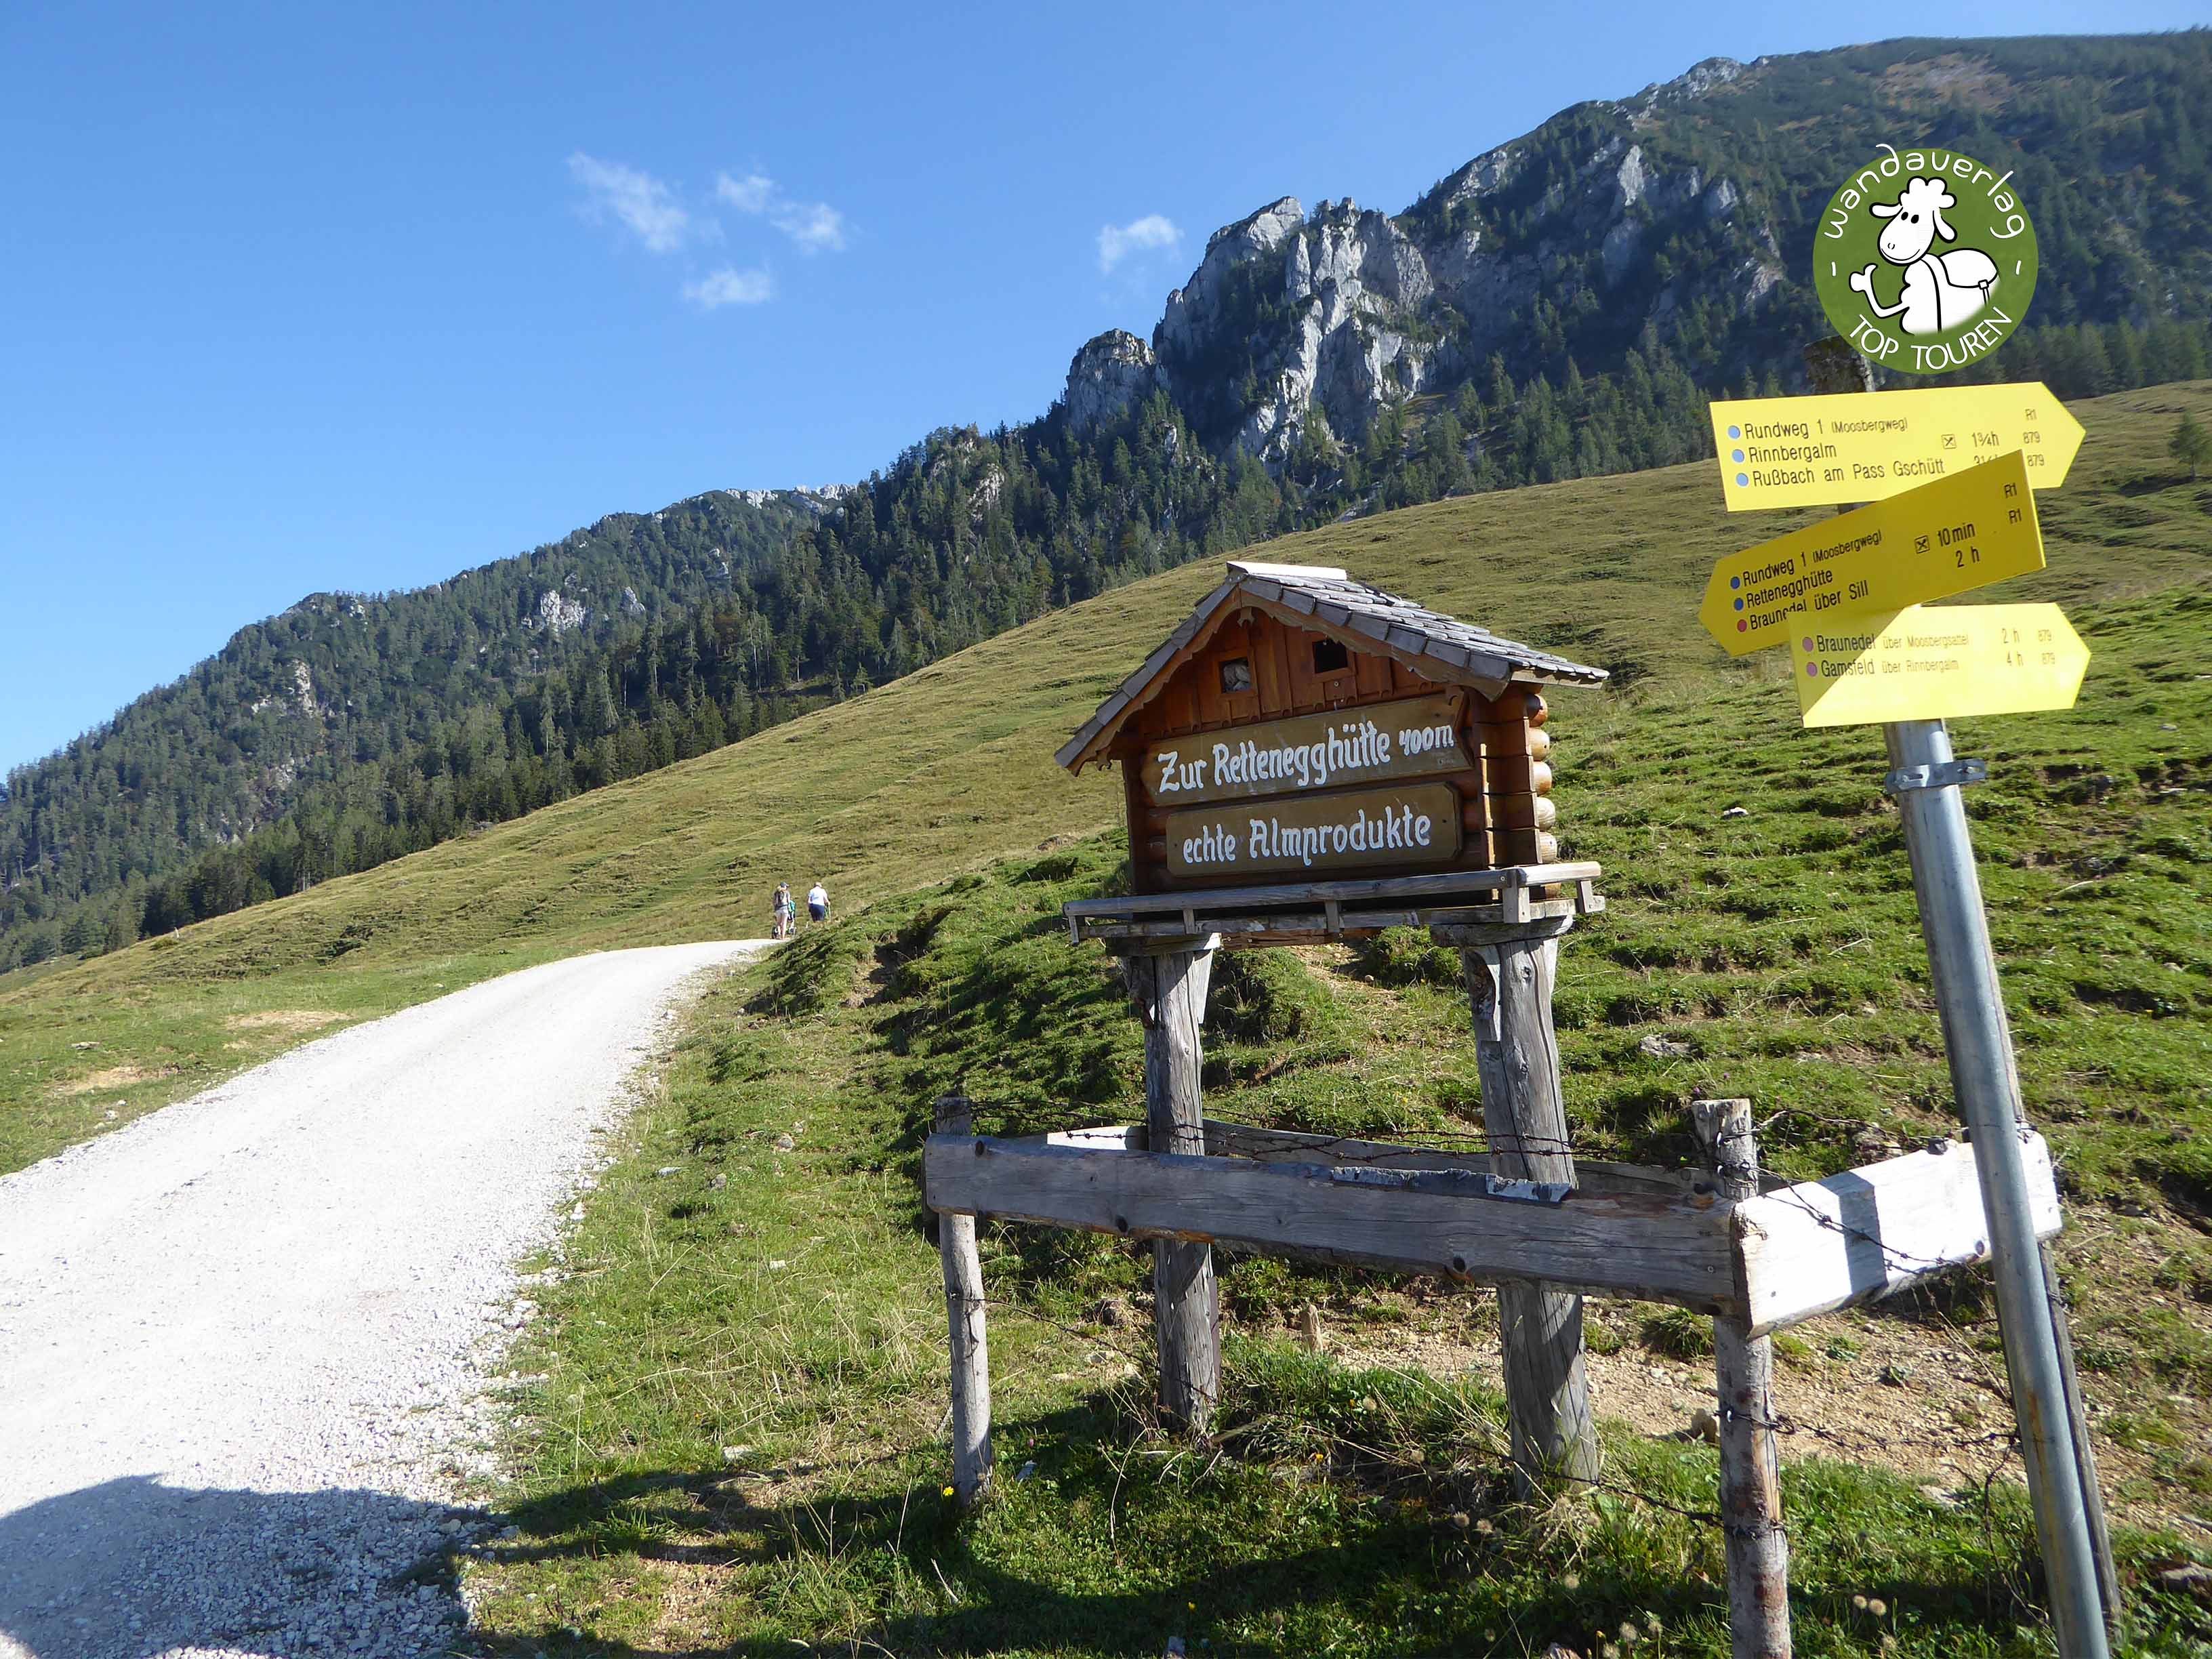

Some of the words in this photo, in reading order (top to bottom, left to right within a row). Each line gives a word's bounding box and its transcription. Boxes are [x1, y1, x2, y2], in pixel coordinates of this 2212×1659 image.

[1744, 422, 1809, 439] Rundweg
[1817, 419, 1823, 434] 1
[2025, 409, 2037, 421] R1
[1748, 443, 1837, 463] Rinnbergalm
[2023, 431, 2041, 444] 879
[1753, 468, 1815, 487] Rußbach
[1824, 468, 1844, 481] am
[1853, 464, 1885, 480] Pass
[1893, 457, 1945, 476] Gschütt
[2027, 454, 2045, 467] 879
[1742, 558, 1795, 586] Rundweg
[1801, 552, 1806, 567] 1
[2004, 483, 2017, 498] R1
[1746, 569, 1833, 609] Rettenegghütte
[2009, 508, 2022, 524] R1
[1815, 591, 1841, 611] über
[1849, 580, 1868, 600] Sill
[1956, 550, 1965, 567] 2
[1971, 546, 1980, 563] h
[1817, 634, 1876, 652] Braunedel
[1883, 636, 1902, 649] über
[1908, 634, 1969, 649] Moosbergsattel
[2001, 628, 2009, 643] 2
[1821, 659, 1875, 677] Gamsfeld
[1882, 661, 1901, 673] über
[1907, 659, 1958, 673] Rinnbergalm
[1157, 751, 1206, 794] Zur
[1212, 720, 1390, 787] Rettenegghütte
[1183, 824, 1236, 864] echte
[1250, 804, 1431, 866] Almprodukte
